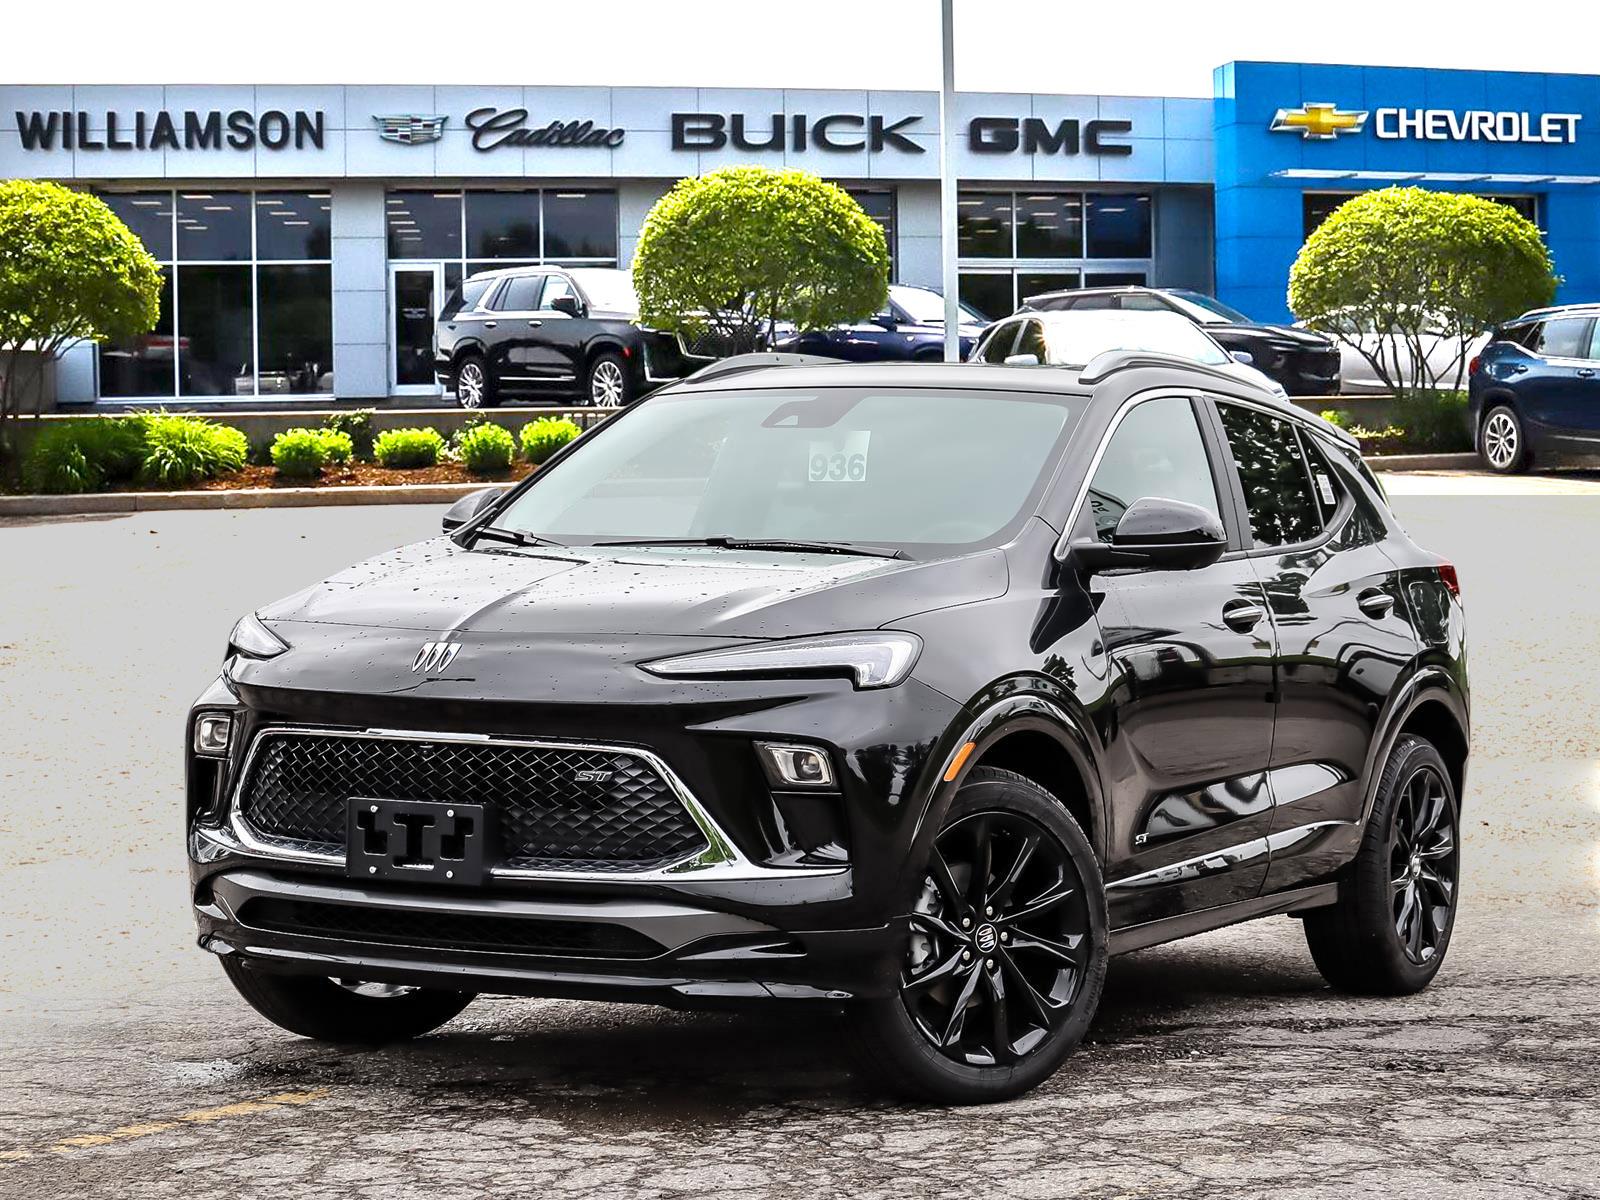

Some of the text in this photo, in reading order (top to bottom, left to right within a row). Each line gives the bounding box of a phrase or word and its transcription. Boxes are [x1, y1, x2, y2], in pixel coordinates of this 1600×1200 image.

[15, 111, 325, 150] WILLIAMSON
[464, 107, 625, 151] Cadillac
[671, 112, 926, 153] BUICK
[969, 117, 1133, 155] GMC
[1376, 107, 1582, 144] CHEVROLET
[810, 453, 865, 481] 936
[574, 770, 613, 782] ST
